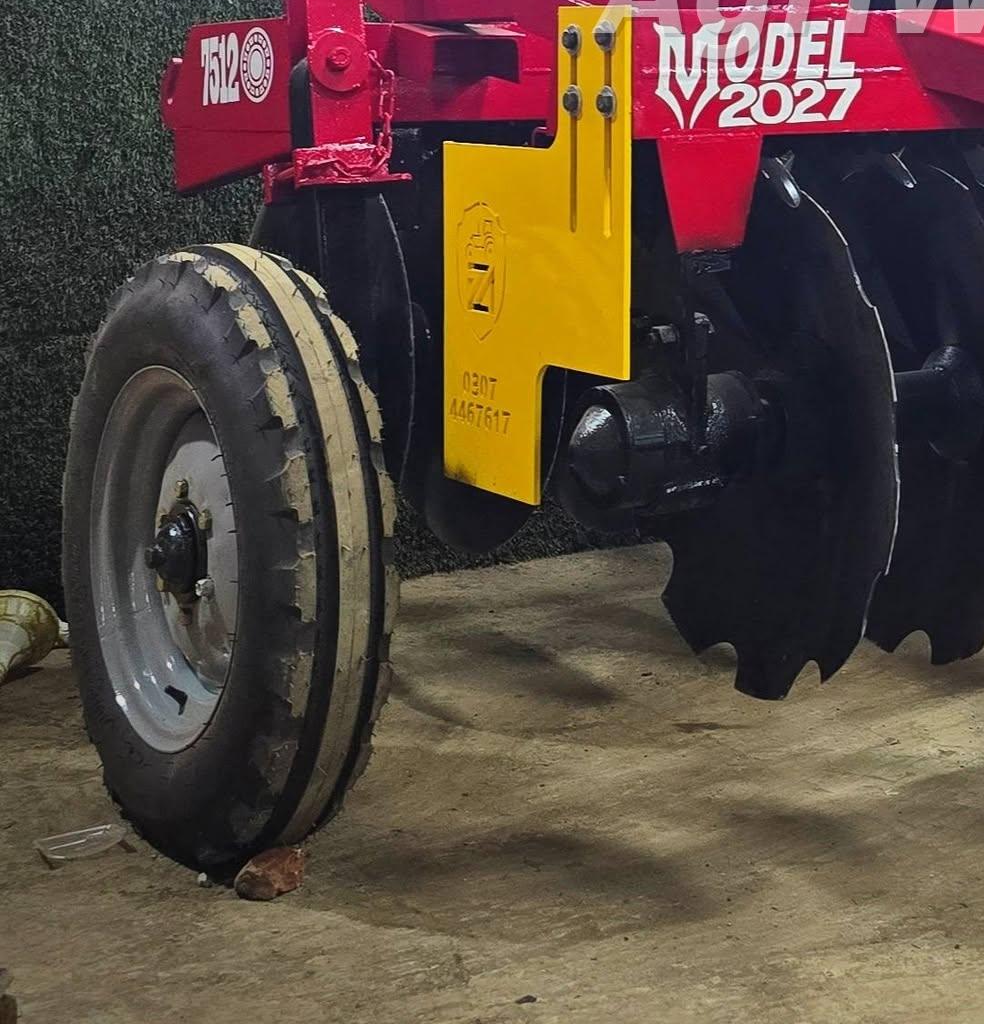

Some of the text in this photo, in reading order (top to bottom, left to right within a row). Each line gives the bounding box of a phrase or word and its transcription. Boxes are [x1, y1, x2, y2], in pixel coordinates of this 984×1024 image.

[201, 32, 240, 106] 7512
[653, 19, 855, 129] MODEL
[718, 78, 862, 127] 2027
